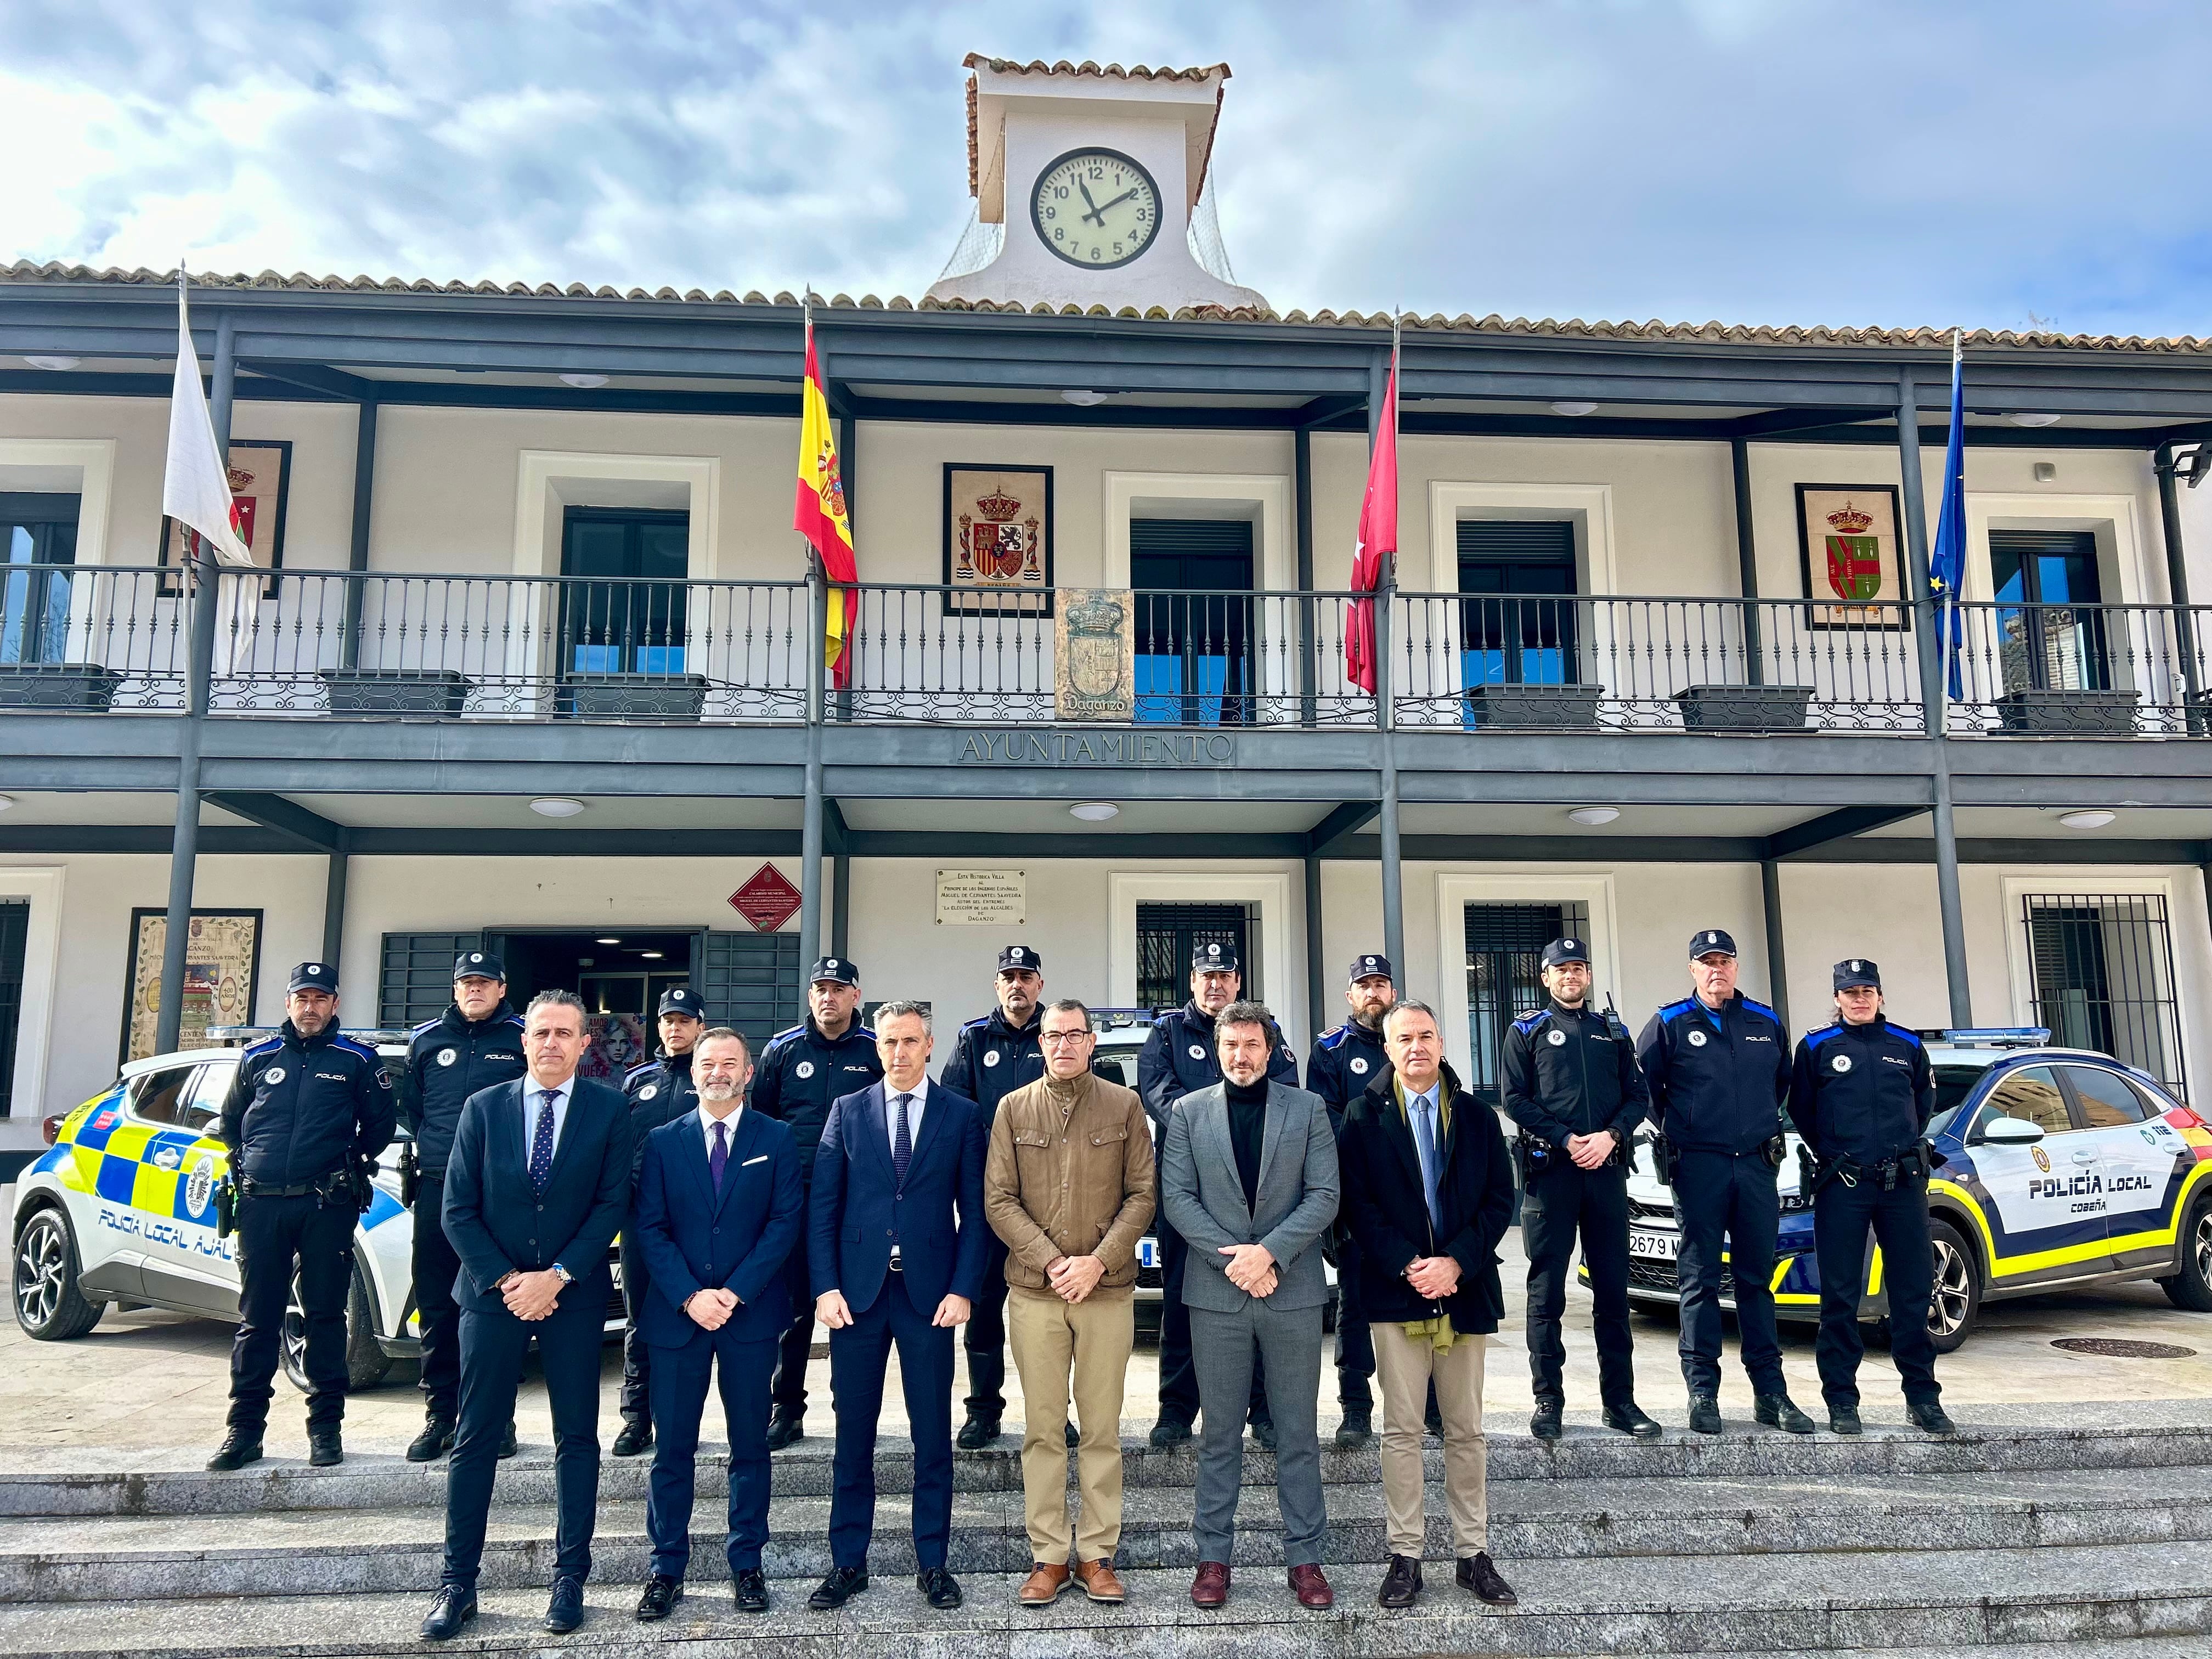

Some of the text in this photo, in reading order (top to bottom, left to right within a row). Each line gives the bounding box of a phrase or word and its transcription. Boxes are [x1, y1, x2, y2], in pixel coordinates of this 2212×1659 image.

[1088, 167, 1103, 180] 12
[1115, 174, 1120, 186] 1
[1053, 186, 1069, 199] 10
[1130, 188, 1139, 200] 2
[1046, 206, 1056, 219] 9
[1136, 208, 1146, 221] 3
[1054, 228, 1064, 240] 8
[1127, 229, 1138, 242] 4
[1070, 241, 1079, 254] 7
[1091, 247, 1101, 259] 6
[1113, 242, 1122, 255] 5
[1064, 693, 1125, 716] Daganzo
[958, 732, 1234, 763] AYUNTAMIENTO
[1882, 1056, 1908, 1066] POLICÍA
[314, 1073, 346, 1081] POLICÍA
[2151, 1125, 2172, 1136] 112
[2029, 1170, 2152, 1199] POLICÍA LOCAL
[2070, 1198, 2106, 1213] COBEÑA
[98, 1209, 233, 1261] POLICÍA LOCAL AJAL
[1629, 1235, 1666, 1255] 2679
